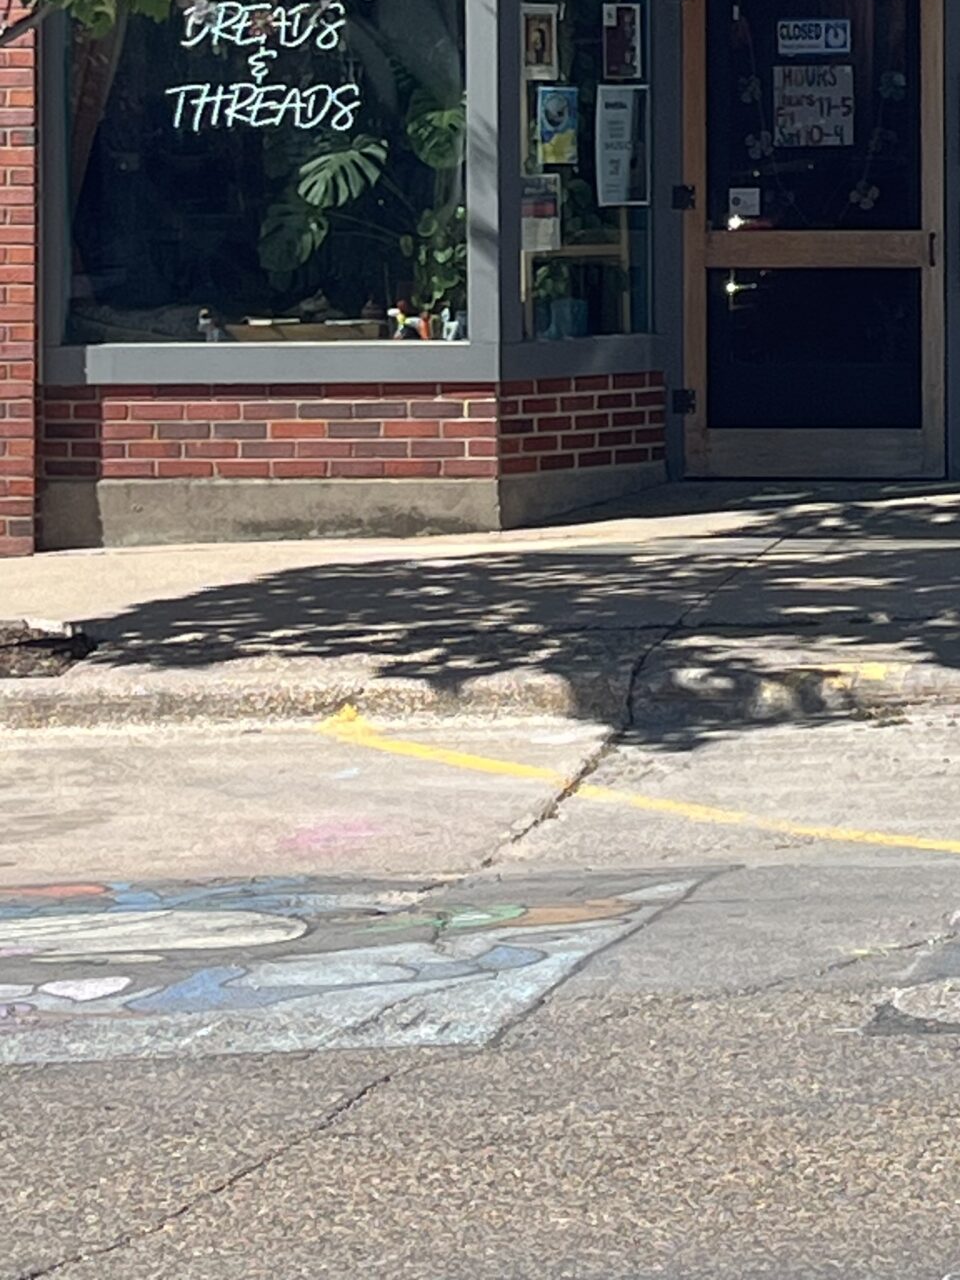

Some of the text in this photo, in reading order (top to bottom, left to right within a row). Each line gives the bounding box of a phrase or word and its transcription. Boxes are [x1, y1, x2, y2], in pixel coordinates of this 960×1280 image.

[180, 1, 347, 50] DREADS
[780, 23, 822, 41] CLOSED
[248, 46, 278, 84] &
[782, 64, 838, 88] HOURS
[164, 82, 362, 132] THREADS
